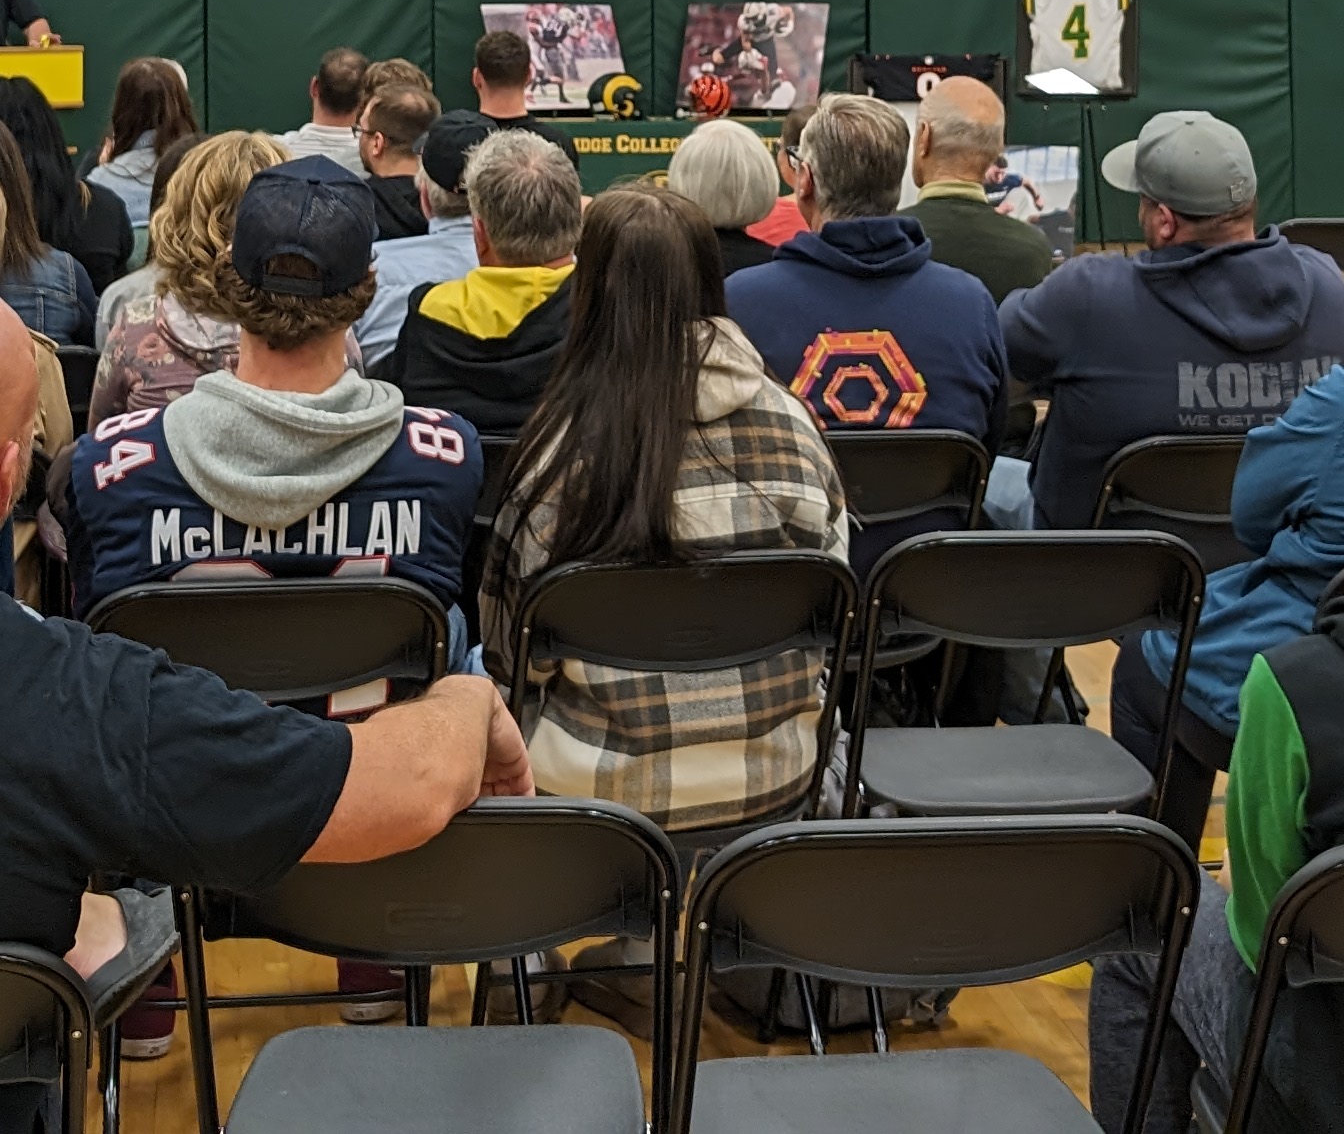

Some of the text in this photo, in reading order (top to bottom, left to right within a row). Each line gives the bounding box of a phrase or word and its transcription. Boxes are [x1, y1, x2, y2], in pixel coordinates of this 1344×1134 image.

[1060, 2, 1091, 60] 4
[1179, 415, 1211, 427] WE
[1217, 415, 1256, 427] GET
